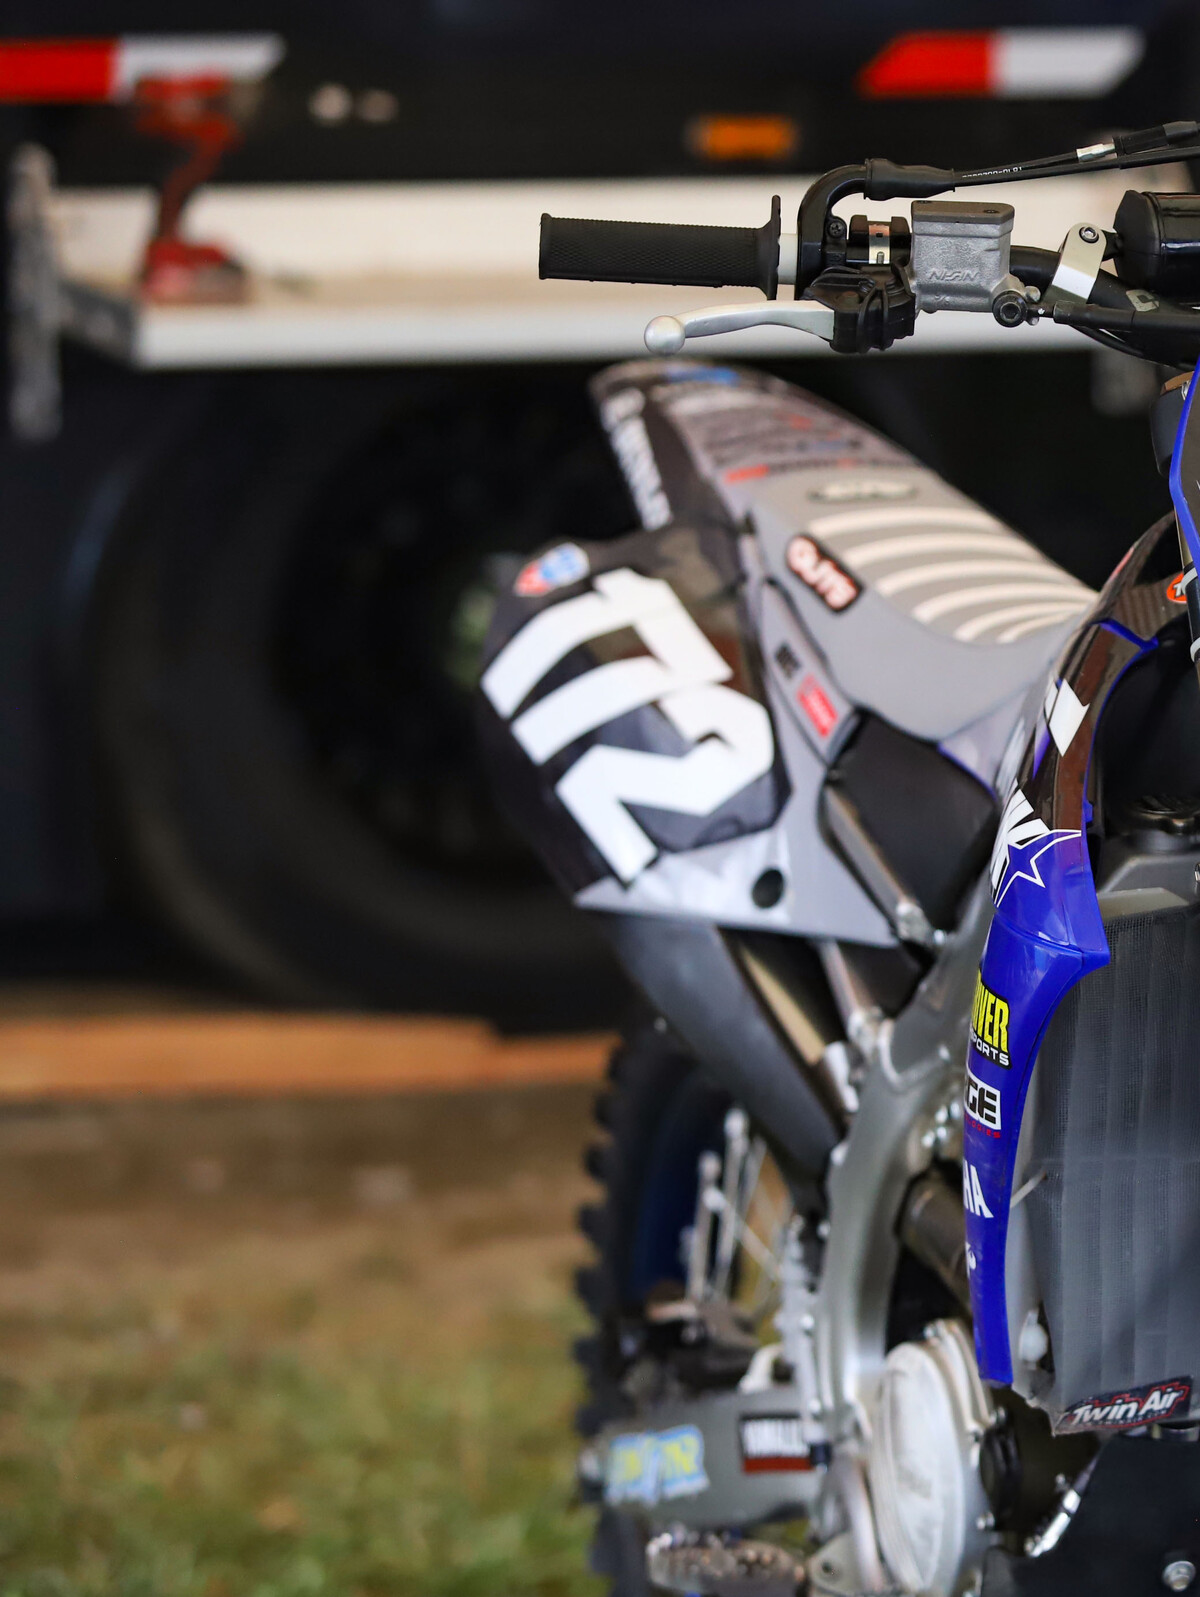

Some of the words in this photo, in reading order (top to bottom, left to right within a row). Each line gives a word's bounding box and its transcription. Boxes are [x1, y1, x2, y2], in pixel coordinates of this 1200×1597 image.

[481, 567, 775, 882] 172
[1070, 1399, 1140, 1426] Twin
[1138, 1386, 1184, 1416] Air
